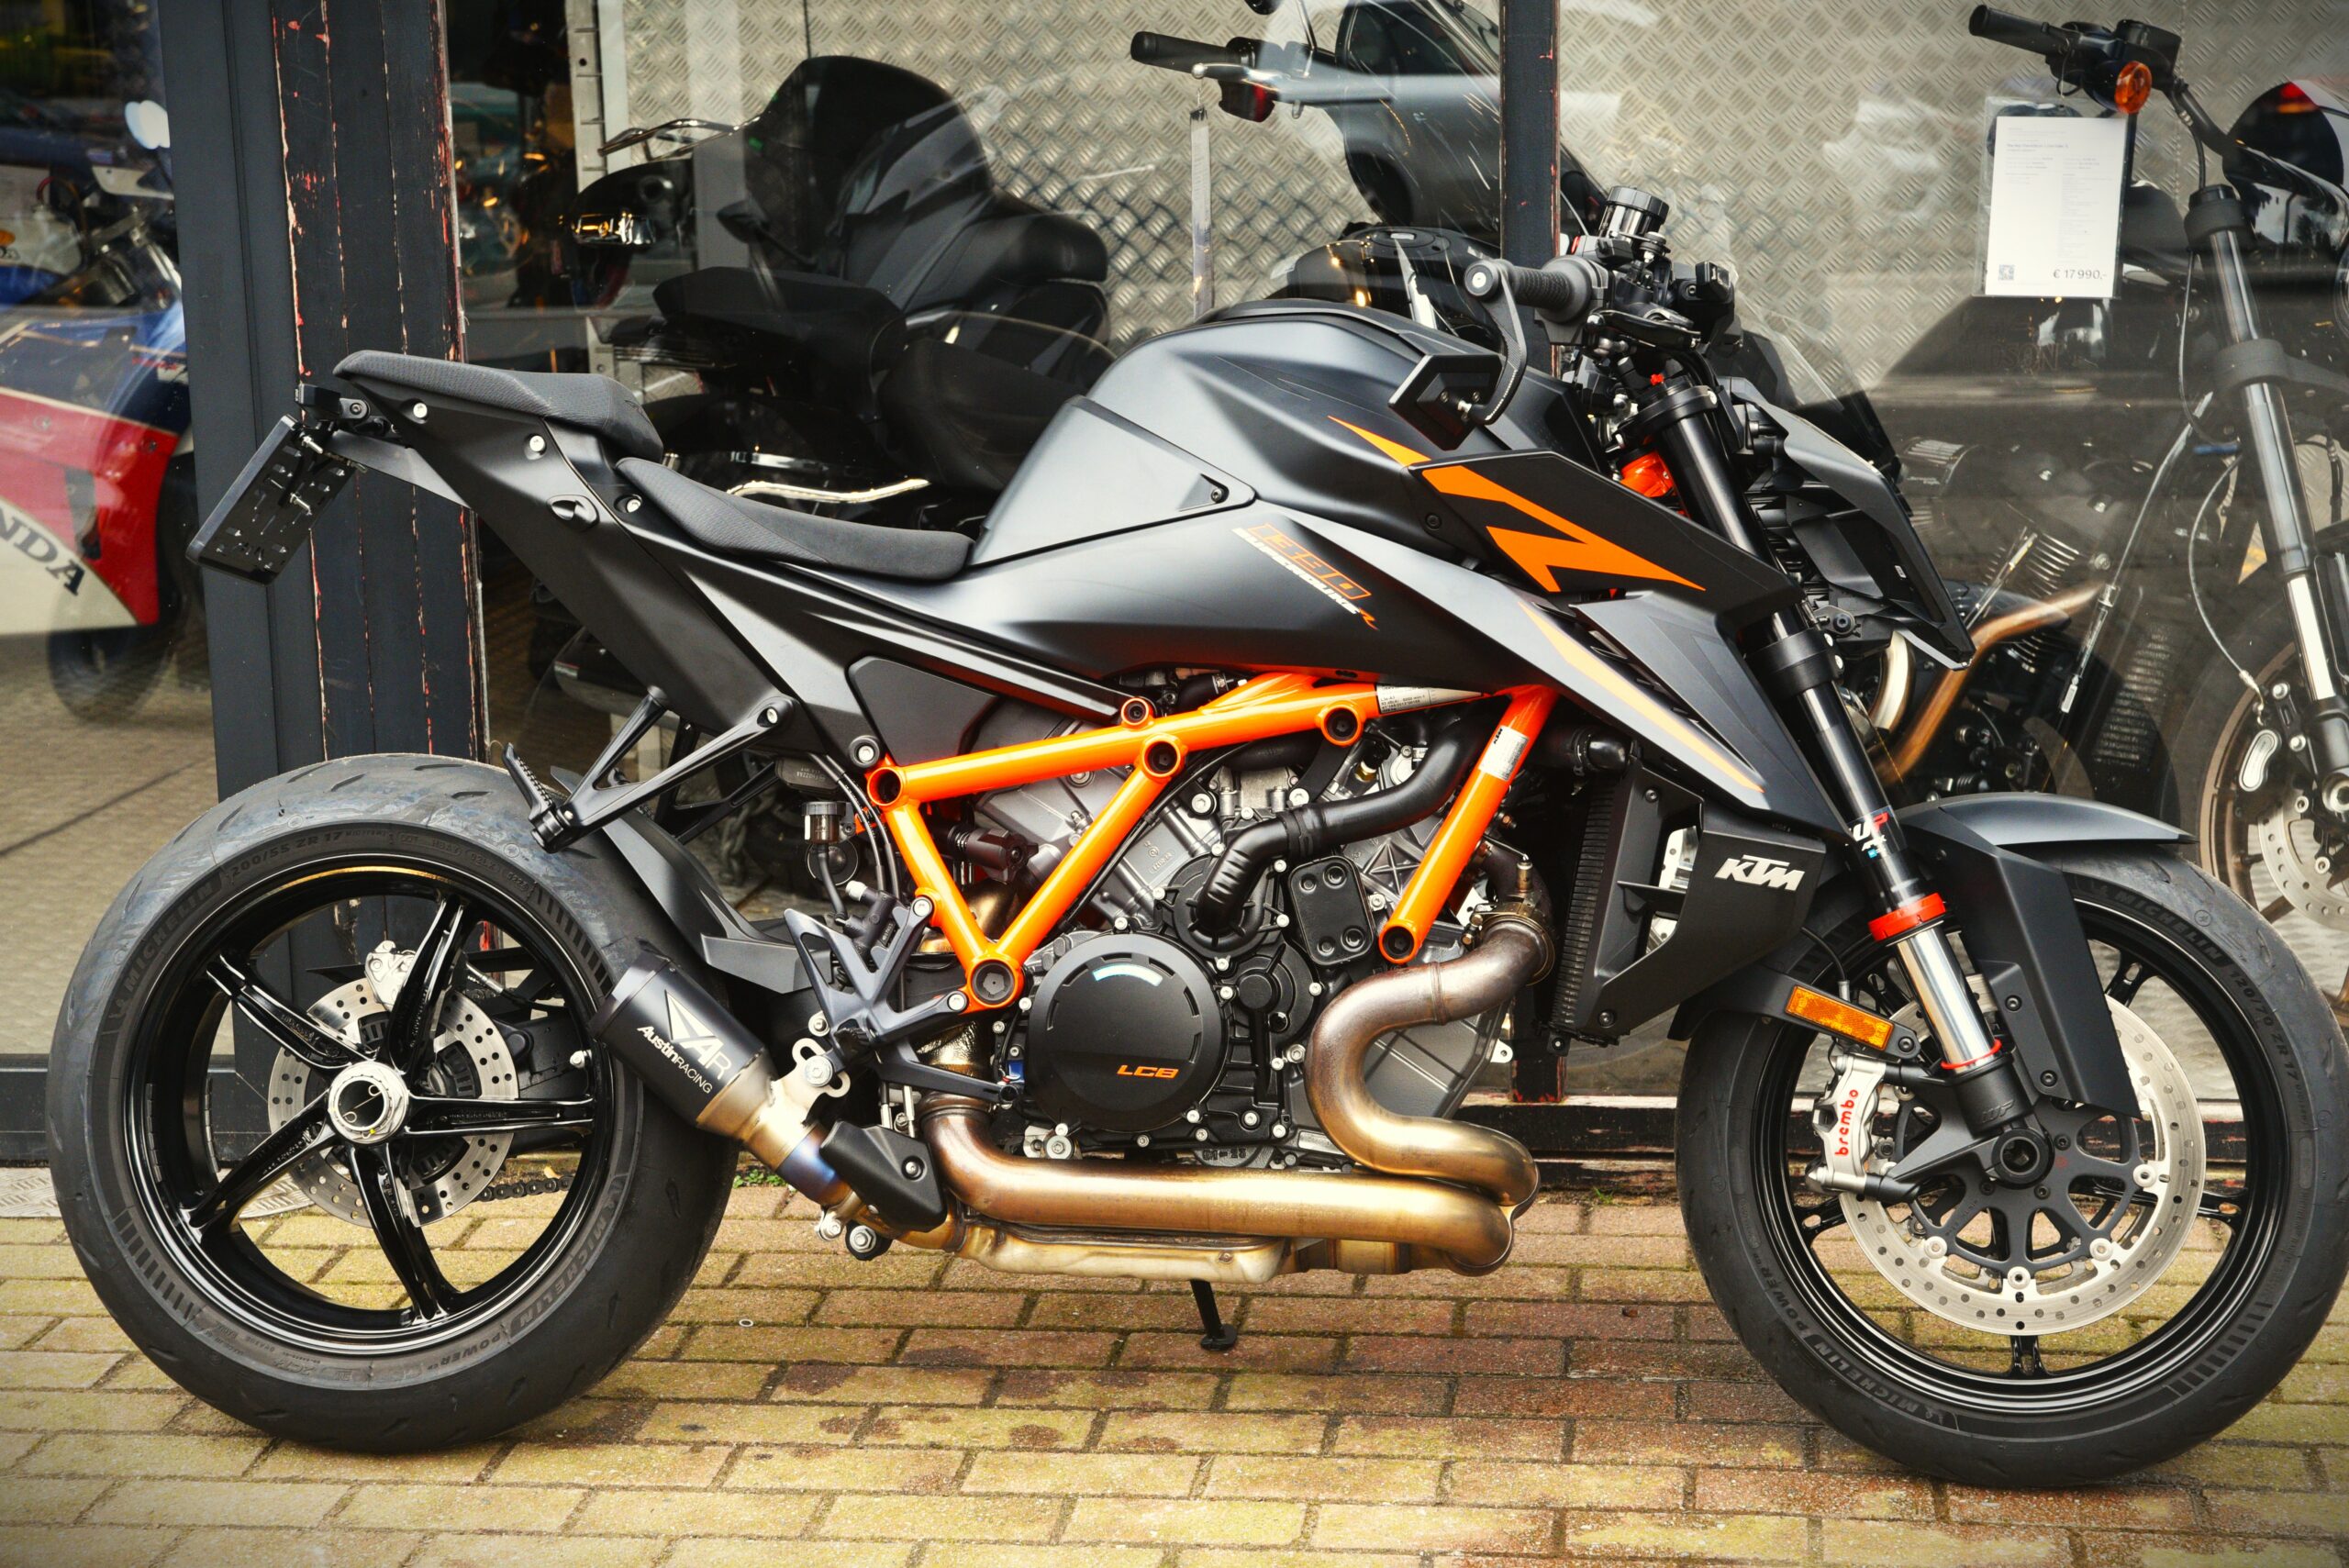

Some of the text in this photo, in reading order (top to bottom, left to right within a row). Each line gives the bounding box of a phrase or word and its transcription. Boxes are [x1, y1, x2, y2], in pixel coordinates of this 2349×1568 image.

[230, 842, 291, 876] 200/55
[295, 835, 319, 849] ZR
[324, 831, 344, 842] 17
[1714, 854, 1805, 892] KTM
[124, 882, 213, 992] MICHELIN
[2114, 890, 2223, 960] MICHELIN
[2229, 970, 2299, 1081] 120/70 ZR 17
[1116, 1064, 1179, 1080] LC8
[1835, 1088, 1859, 1157] brembo
[518, 1215, 607, 1328] MICHELIN
[1761, 1266, 1810, 1331] POWER
[440, 1332, 501, 1365] POWER
[1814, 1341, 1921, 1413] MICHELIN
